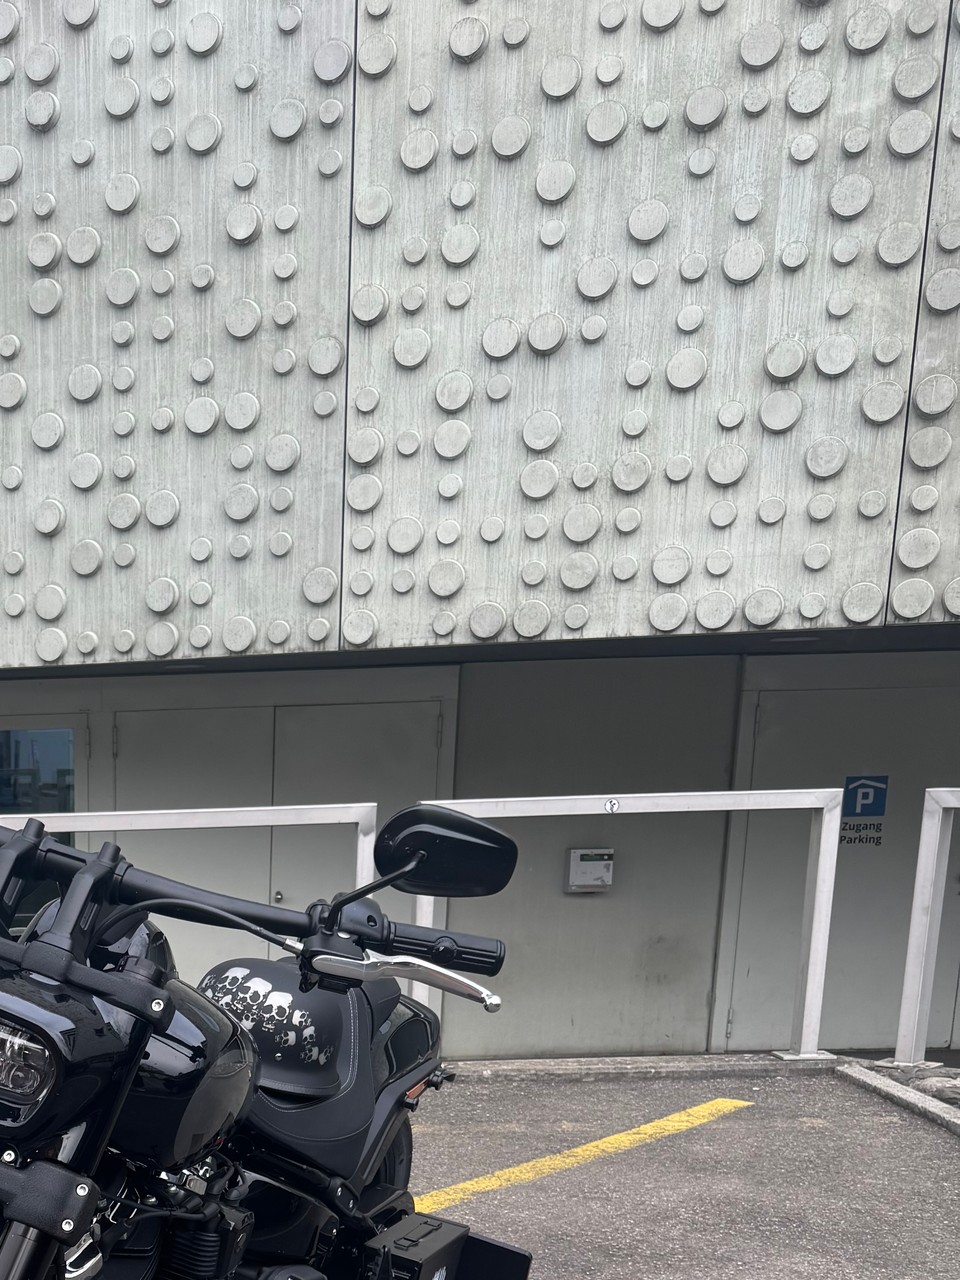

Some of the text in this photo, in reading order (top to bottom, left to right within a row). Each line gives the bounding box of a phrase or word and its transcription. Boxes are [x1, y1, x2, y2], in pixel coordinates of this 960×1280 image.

[856, 788, 874, 813] P
[841, 822, 882, 833] Zugang
[840, 834, 882, 846] Parking
